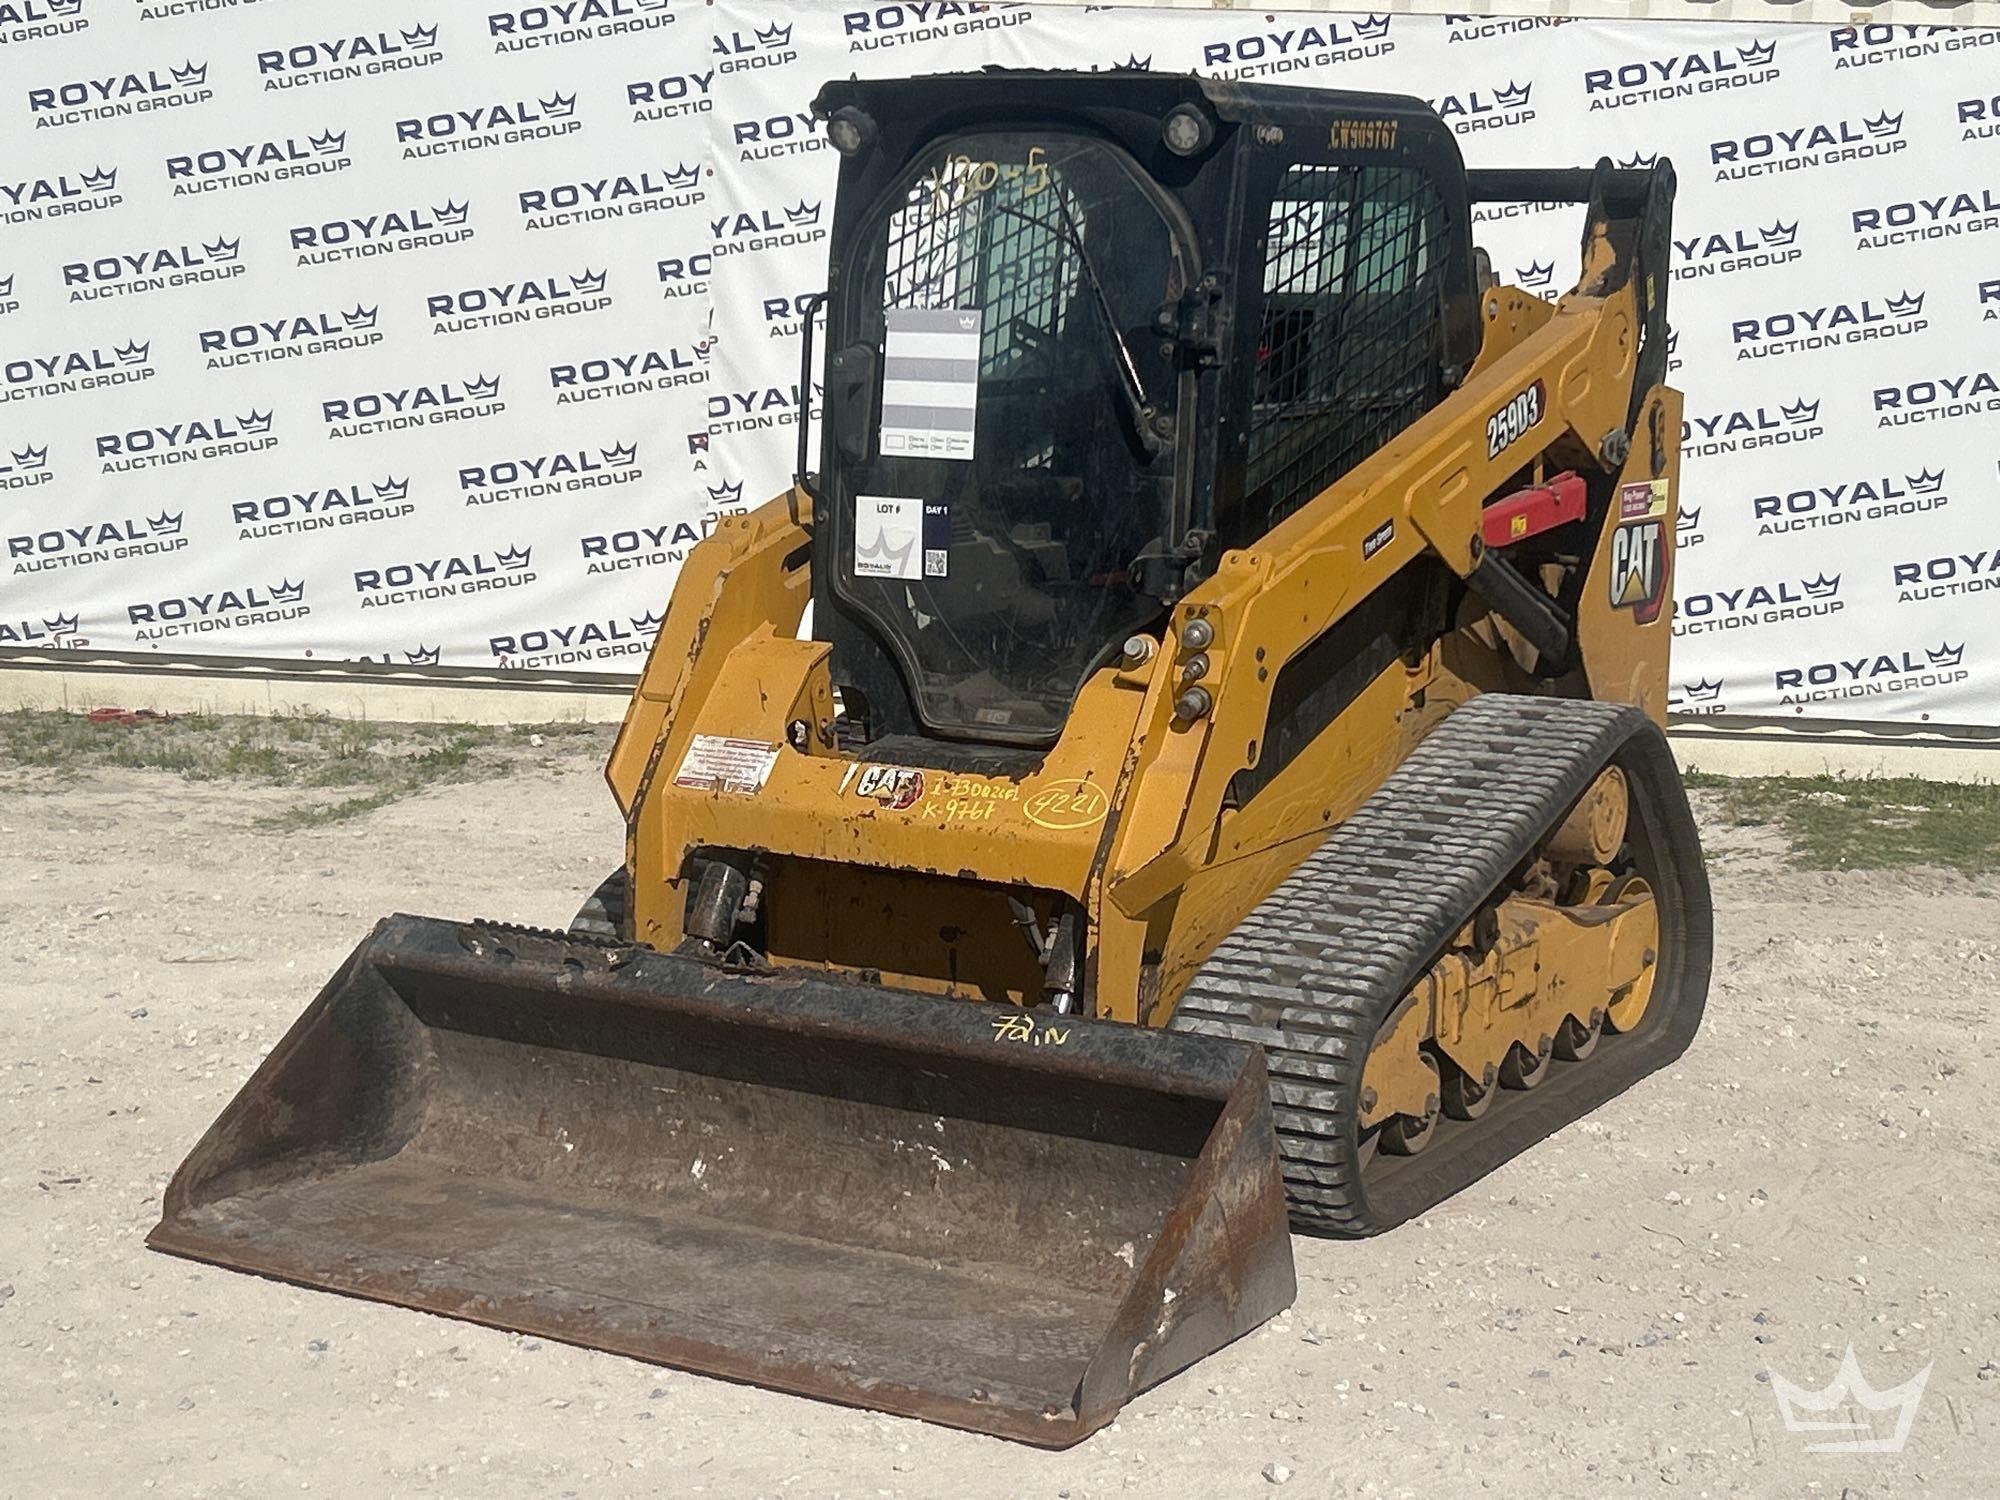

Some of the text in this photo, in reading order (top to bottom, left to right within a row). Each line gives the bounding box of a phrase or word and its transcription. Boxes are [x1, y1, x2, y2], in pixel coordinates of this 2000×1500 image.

[12, 19, 89, 41] GROUP
[488, 0, 633, 36] ROYAL
[495, 14, 675, 54] AUCTION GROUP
[849, 12, 1031, 53] AUCTION GROUP
[257, 33, 401, 74] ROYAL
[720, 51, 797, 74] GROUP
[1204, 24, 1352, 67] ROYAL
[1315, 42, 1395, 66] GROUP
[1835, 31, 2000, 70] AUCTION GRO
[264, 52, 443, 91] AUCTION GROUP
[627, 68, 713, 104] ROY
[1585, 50, 1737, 94] ROYAL
[1590, 69, 1780, 111] AUCTION GROUP
[29, 71, 171, 112] ROYAL
[36, 90, 213, 129] AUCTION GROUP
[396, 102, 540, 143] ROYAL
[633, 99, 712, 122] AUCTIO
[733, 113, 818, 144] ROY
[1455, 110, 1536, 134] GROUP
[403, 121, 581, 160] AUCTION GROUP
[1331, 120, 1398, 149] CW909767
[1710, 121, 1863, 164] ROYAL
[166, 139, 310, 179] ROYAL
[174, 158, 351, 196] AUCTION GROUP
[1715, 140, 1907, 182] AUCTION GROUP
[0, 177, 82, 205] YAL
[47, 195, 122, 217] GROUP
[519, 173, 663, 213] ROYAL
[290, 210, 433, 249] ROYAL
[526, 192, 705, 231] AUCTION GROUP
[711, 210, 784, 239] YAL
[297, 229, 474, 267] AUCTION GROUP
[749, 229, 826, 251] GROUP
[1673, 230, 1758, 260] YAL
[1857, 223, 1961, 250] AUCTION
[63, 246, 204, 285] ROYAL
[1720, 249, 1802, 272] GROUP
[70, 265, 245, 303] AUCTION GROUP
[427, 278, 570, 318] ROYAL
[199, 314, 342, 353] ROYAL
[434, 297, 612, 335] AUCTION GROUP
[1732, 301, 1885, 343] ROYAL
[207, 333, 383, 370] AUCTION GROUP
[1737, 320, 1928, 360] AUCTION GROUP
[0, 368, 155, 403] UCTION GROUP
[3, 350, 115, 385] OYAL
[550, 348, 693, 387] ROYAL
[322, 384, 464, 422] ROYAL
[557, 380, 653, 405] AUCTION
[708, 385, 812, 418] OYAL
[1873, 373, 2000, 411] ROYA
[329, 403, 505, 439] AUCTION GROUP
[709, 417, 772, 435] CTION
[1487, 386, 1538, 457] 259D3
[1878, 402, 1981, 428] AUCTION
[96, 419, 237, 457] ROYAL
[102, 437, 278, 474] AUCTION GROUP
[1681, 427, 1823, 458] TION GROUP
[459, 451, 601, 490] ROYAL
[466, 470, 642, 506] AUCTION GROUP
[232, 486, 373, 524] ROYAL
[876, 504, 893, 513] LOT
[925, 505, 941, 514] DAY
[1754, 478, 1905, 519] ROYAL
[1758, 497, 1947, 536] AUCTION GROUP
[8, 520, 147, 558] ROYAL
[239, 504, 414, 540] AUCTION GROUP
[14, 538, 188, 575] AUCTION GROUP
[354, 554, 496, 592] ROYAL
[587, 550, 682, 575] AUCTION
[1611, 523, 1659, 606] CAT
[128, 588, 269, 625] ROYAL
[361, 573, 537, 608] AUCTION GROUP
[1898, 577, 2000, 603] AUCTION
[135, 606, 310, 641] AUCTION GROUP
[1672, 601, 1844, 637] UCTION GROUP
[490, 620, 631, 656] ROYAL
[498, 649, 592, 669] AUCTION
[1776, 652, 1925, 690] ROYAL
[1779, 671, 1968, 705] AUCTION GROUP
